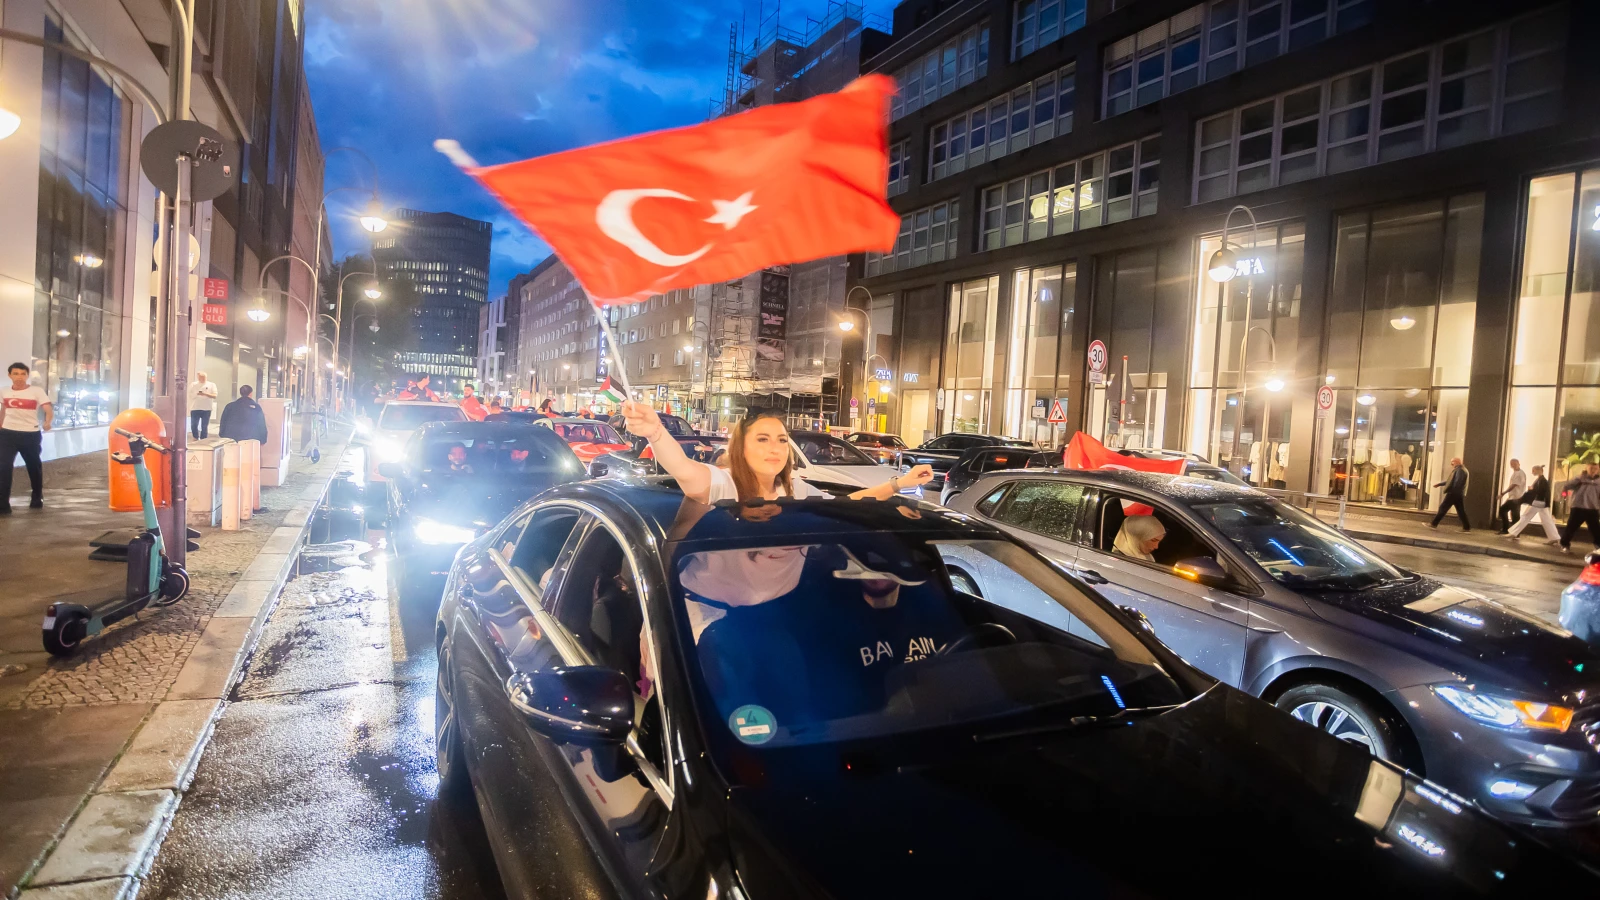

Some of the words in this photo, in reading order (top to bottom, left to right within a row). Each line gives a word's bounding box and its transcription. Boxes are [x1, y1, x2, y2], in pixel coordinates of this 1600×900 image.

[206, 306, 223, 315] UNI
[205, 314, 224, 323] QLO
[598, 331, 607, 375] PLAZA
[1092, 348, 1103, 364] 30
[1321, 392, 1331, 404] 30
[746, 710, 758, 724] 4
